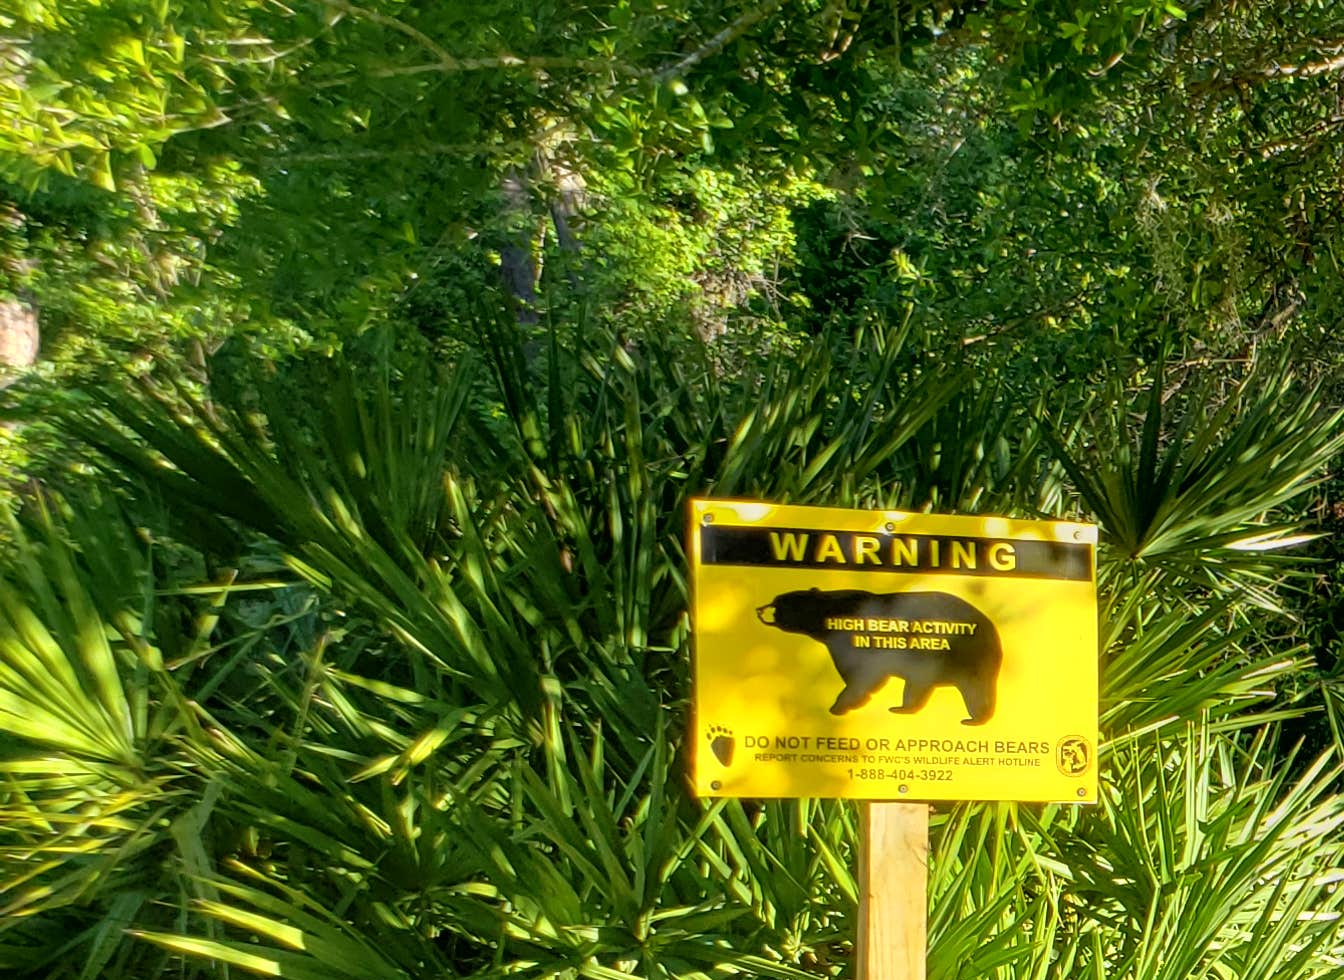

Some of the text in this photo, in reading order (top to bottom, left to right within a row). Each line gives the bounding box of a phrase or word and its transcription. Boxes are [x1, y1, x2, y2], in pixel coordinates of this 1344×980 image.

[769, 532, 1017, 572] WARNING
[827, 618, 977, 635] HIGH BEAR ACTIVITY
[855, 636, 951, 650] IN THIS AREA
[744, 735, 1050, 754] DO NOT FEED OR APPROACH BEARS
[754, 753, 1041, 767] REPORT CONCERNS TO FWC'S WILDLIFE ALERT HOTLINE
[847, 768, 953, 781] 1-888-404-3922
